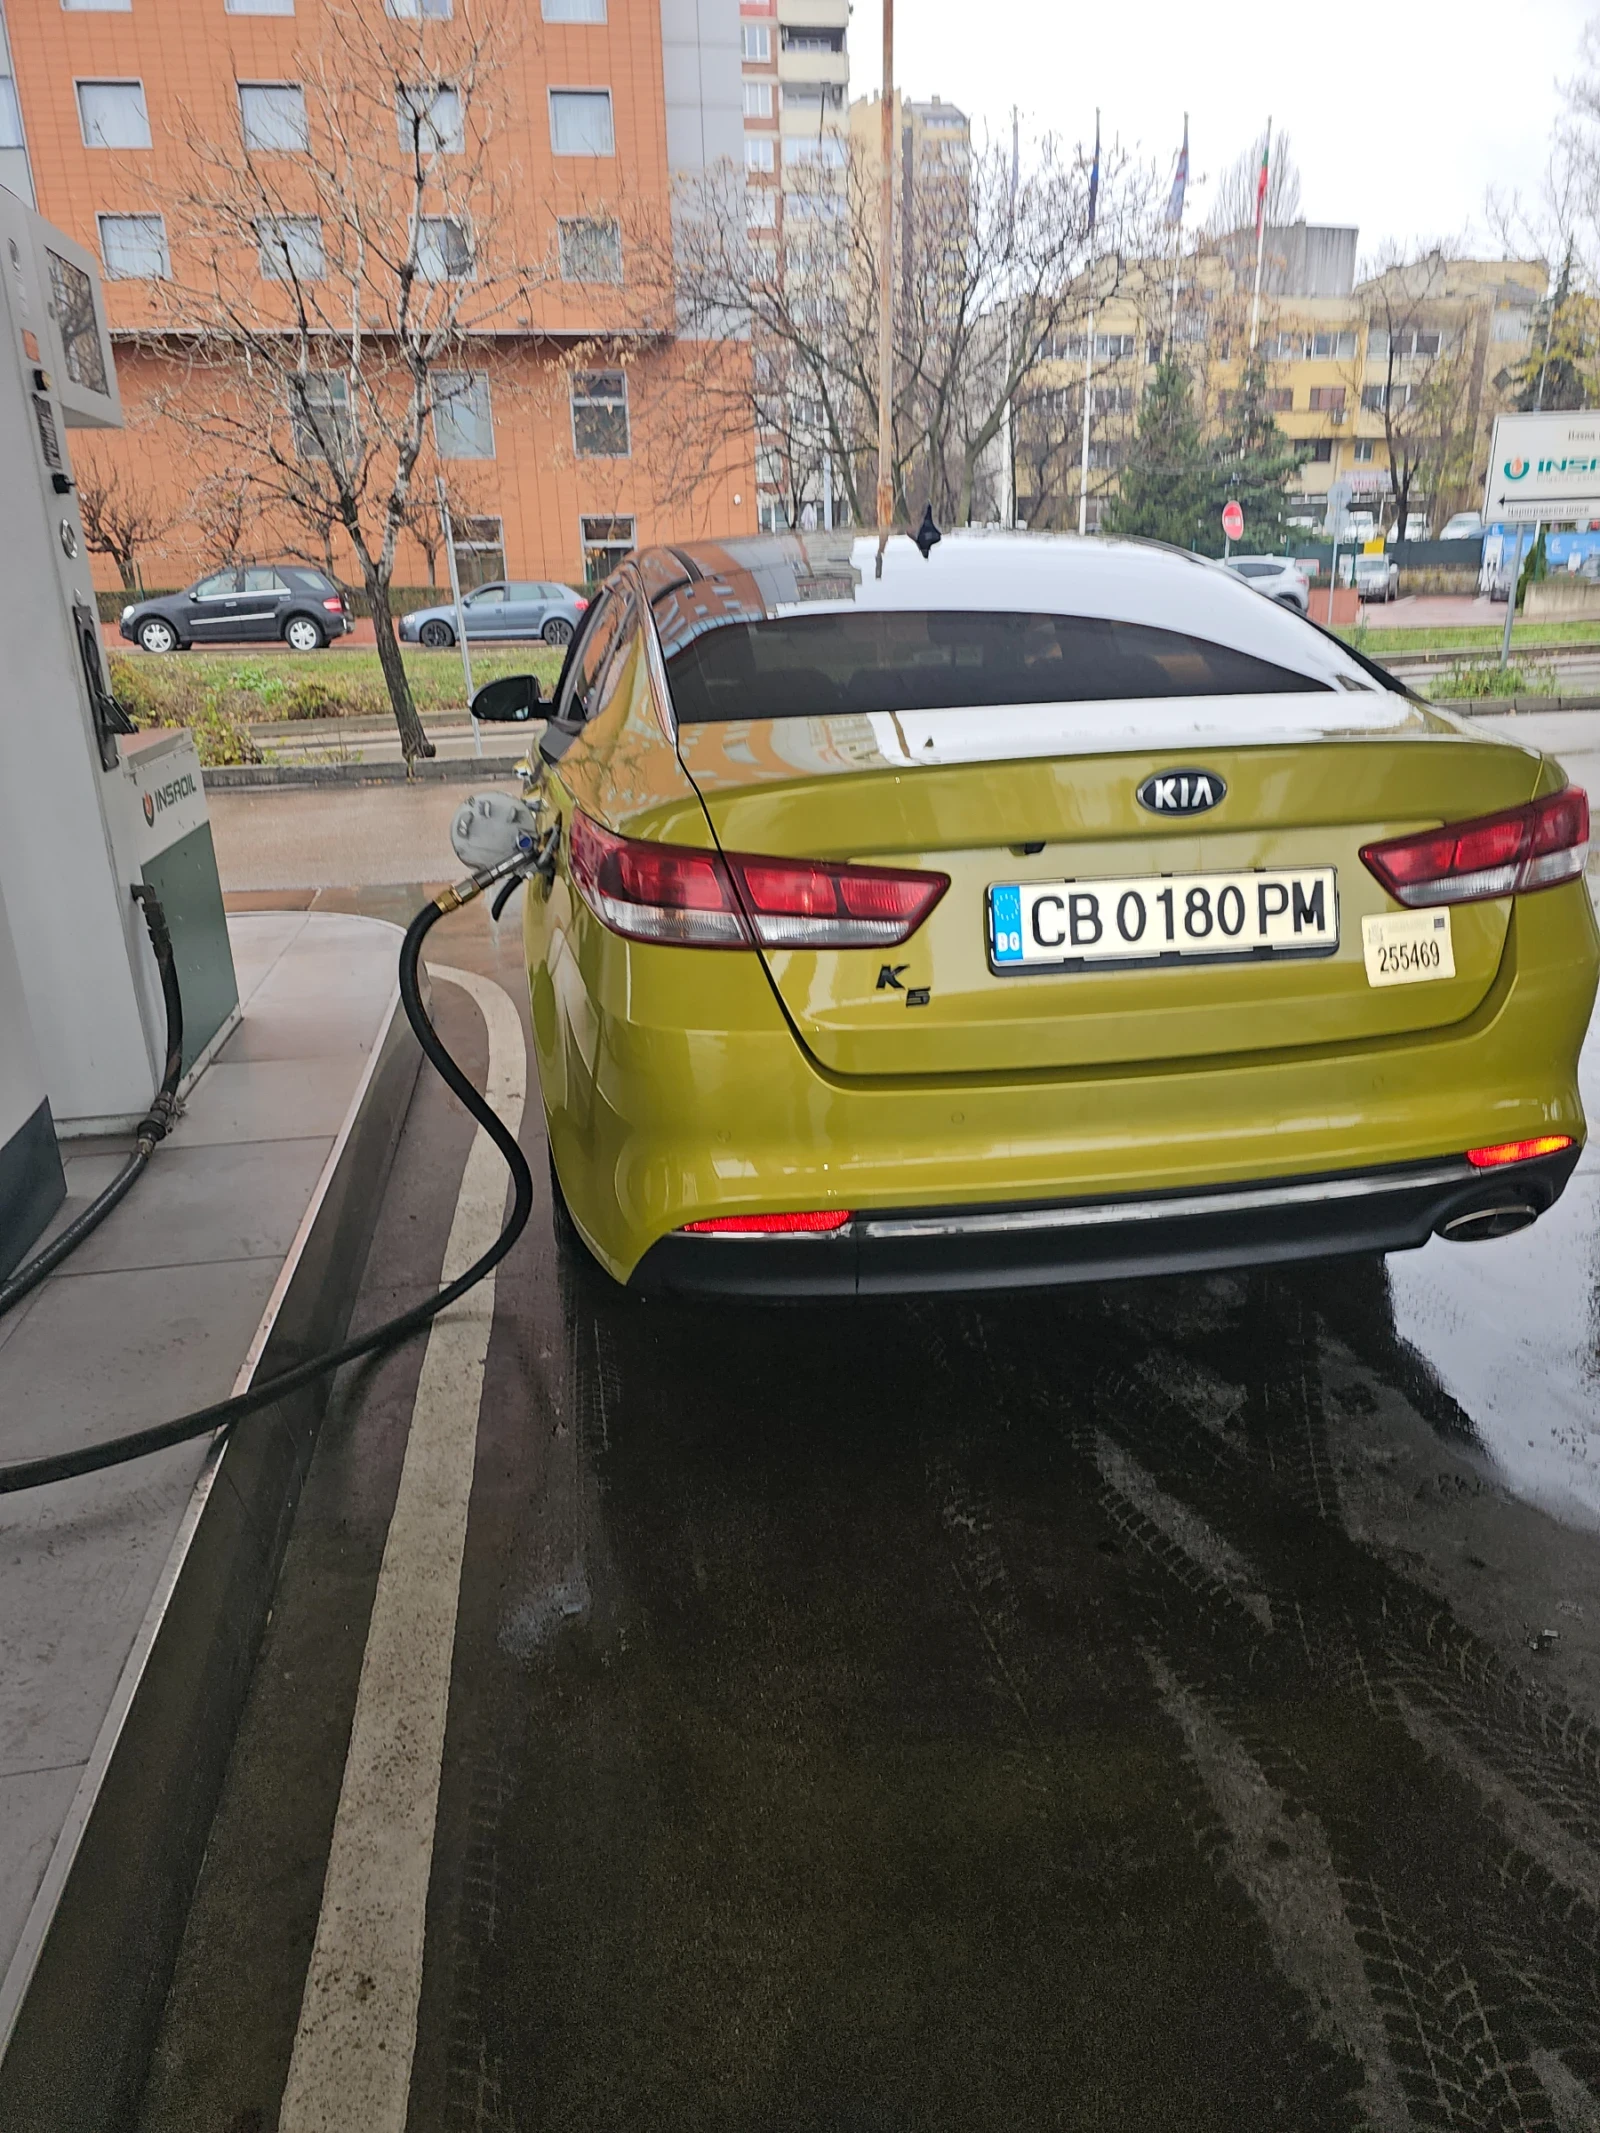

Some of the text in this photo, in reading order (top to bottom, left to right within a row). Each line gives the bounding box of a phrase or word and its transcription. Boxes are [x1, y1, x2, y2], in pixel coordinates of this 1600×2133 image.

[1155, 776, 1214, 808] KIA
[997, 880, 1326, 951] BG CB 0180 PM
[1378, 940, 1440, 973] 255469
